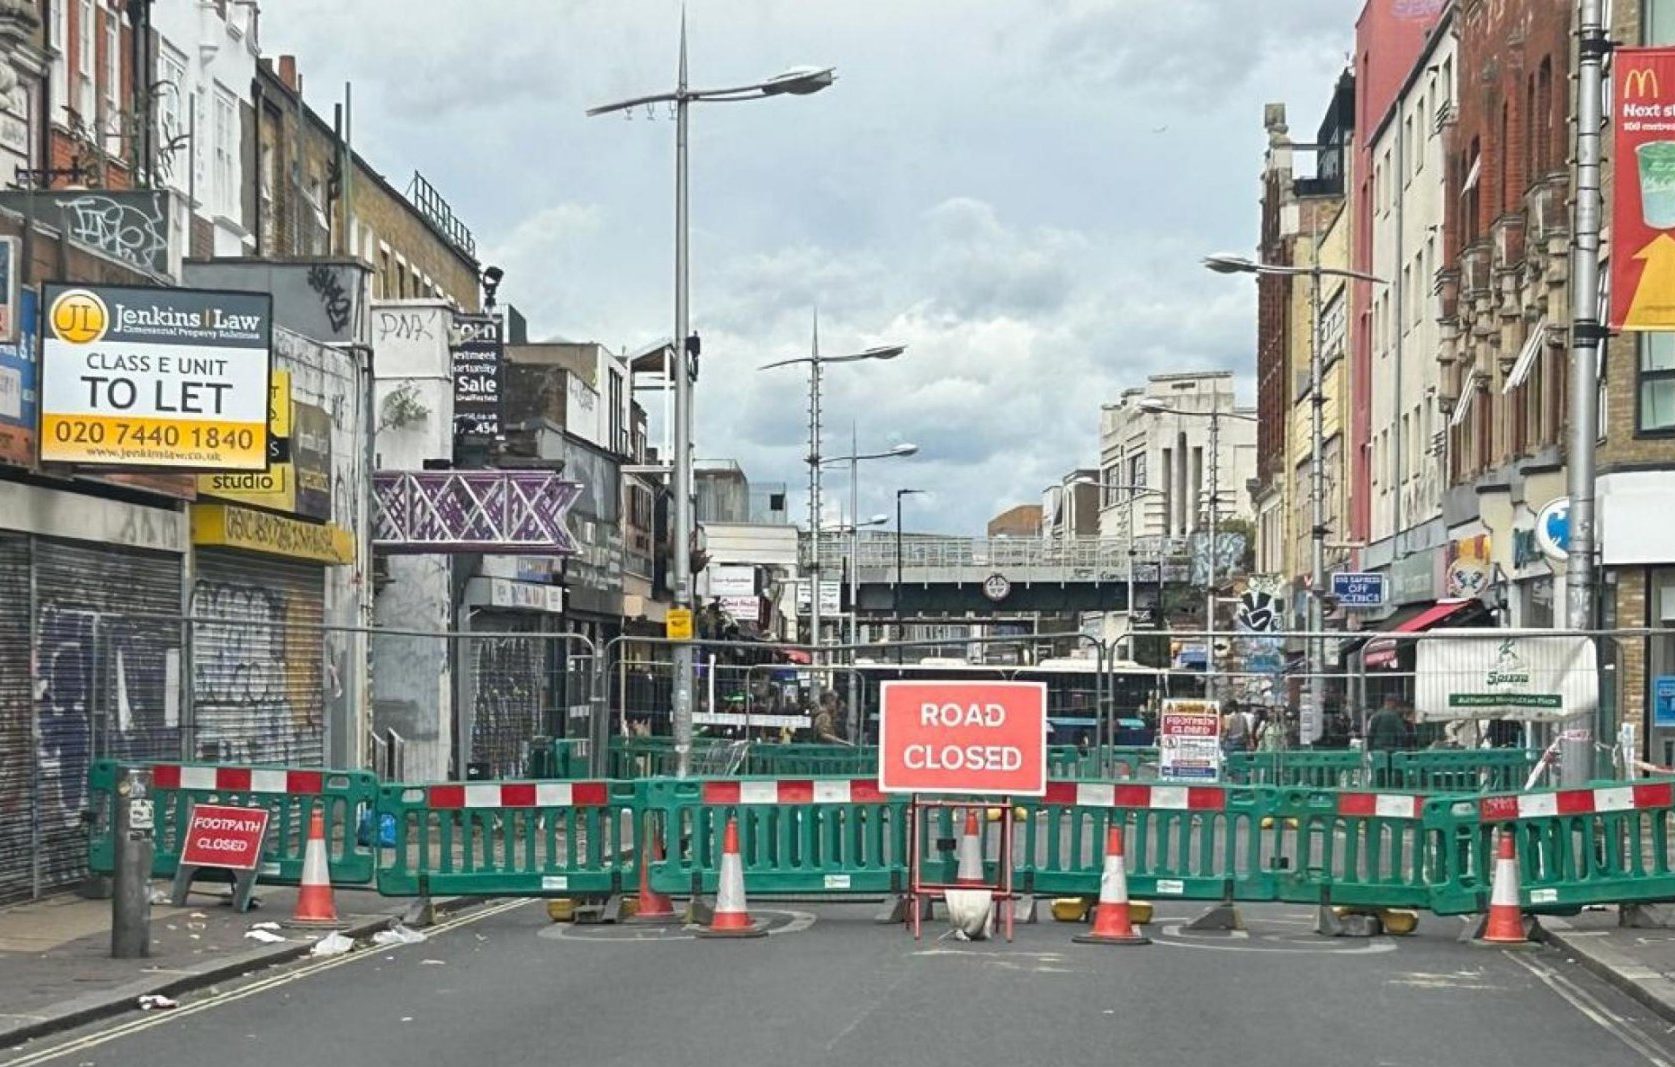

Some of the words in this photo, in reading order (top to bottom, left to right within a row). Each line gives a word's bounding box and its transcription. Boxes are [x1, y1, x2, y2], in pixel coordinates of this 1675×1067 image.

[1623, 103, 1660, 117] Next
[113, 303, 201, 332] Jenkins
[212, 308, 260, 331] Law
[86, 353, 150, 372] CLASS
[159, 357, 171, 373] E
[178, 357, 228, 375] UNIT
[458, 375, 497, 392] Sale
[80, 375, 136, 409] TO
[155, 380, 233, 413] LET
[56, 421, 104, 443] 020
[116, 424, 180, 446] 7440
[191, 427, 253, 450] 1840
[86, 448, 222, 461] www.jenkinslaw.co.uk
[213, 474, 273, 490] studio
[920, 703, 1006, 727] ROAD
[1171, 726, 1211, 735] CLOSED
[903, 745, 1022, 771] CLOSED
[195, 817, 261, 832] FOOTPATH
[196, 838, 248, 852] CLOSED
